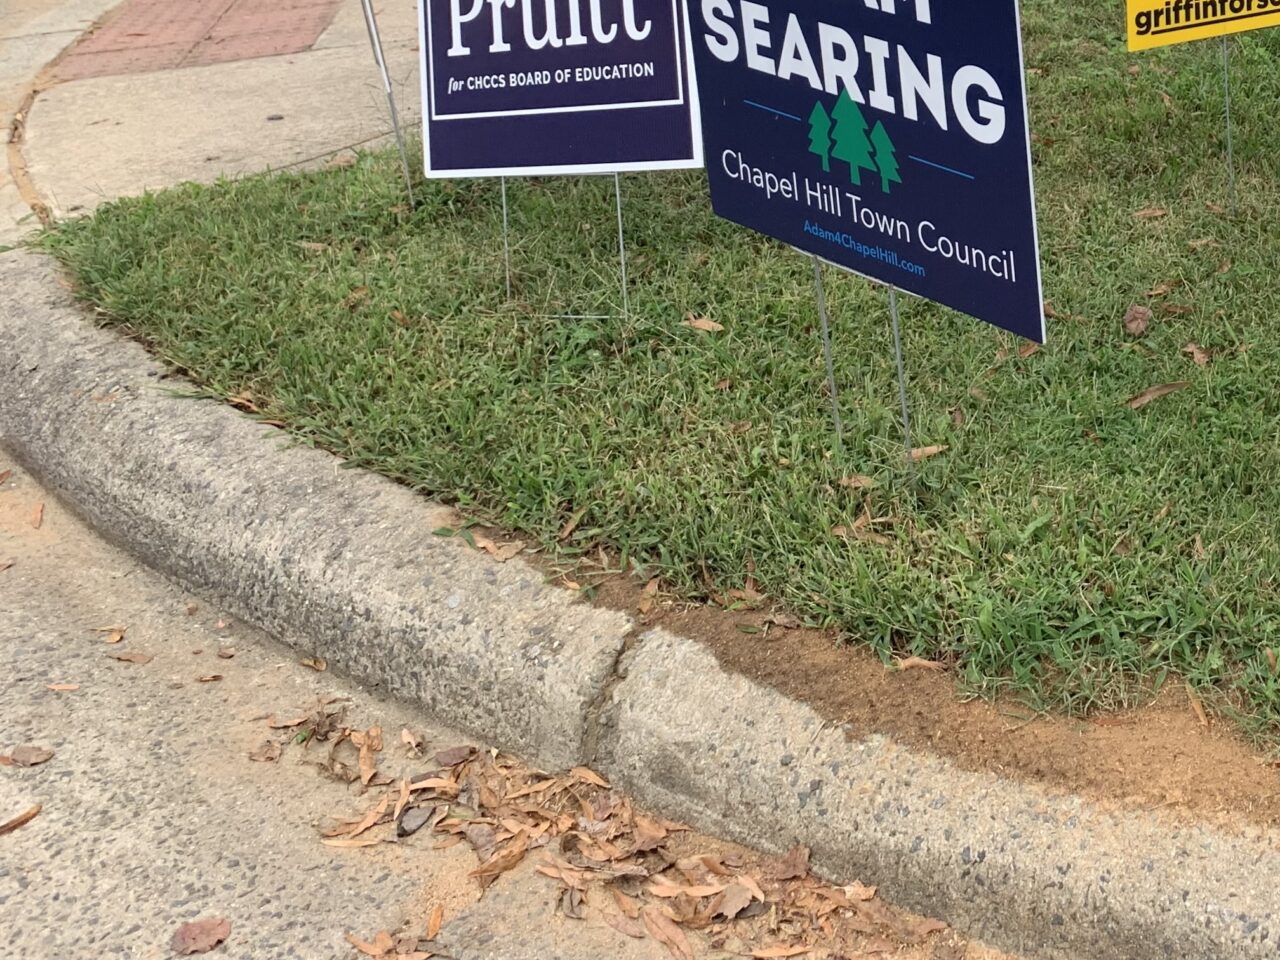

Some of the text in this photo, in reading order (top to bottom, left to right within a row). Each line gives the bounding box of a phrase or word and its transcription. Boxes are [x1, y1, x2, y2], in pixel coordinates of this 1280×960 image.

[448, 62, 655, 94] for CHCCS BOARD OF EDUCATION
[722, 148, 1017, 283] Chapel Hill Town Council
[803, 220, 926, 277] Adam4ChapelHill.com
